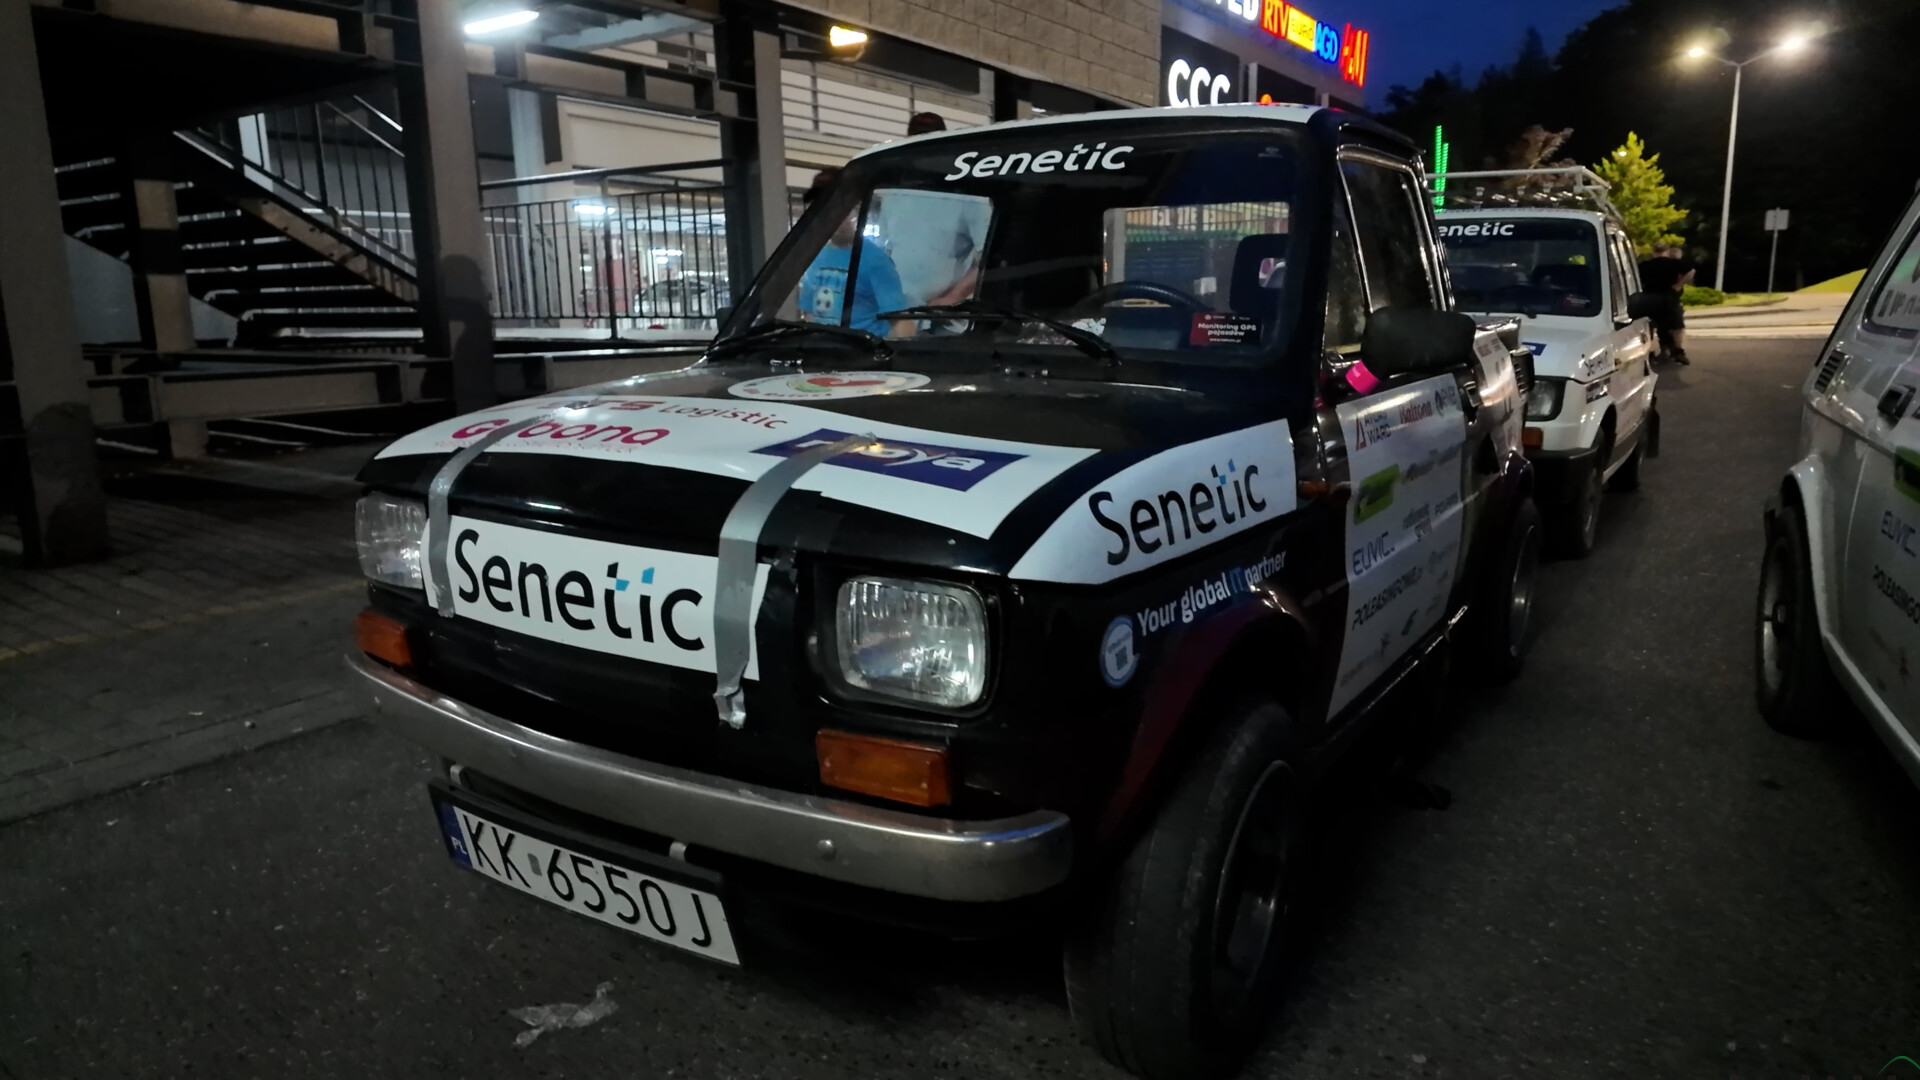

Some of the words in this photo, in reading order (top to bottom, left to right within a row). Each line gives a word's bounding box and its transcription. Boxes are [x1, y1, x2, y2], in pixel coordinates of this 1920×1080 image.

[1264, 0, 1289, 38] RTV
[1316, 22, 1339, 63] AGD
[1168, 58, 1230, 108] CCC
[944, 142, 1134, 181] Senetic
[1198, 322, 1239, 331] Monitoring
[1240, 323, 1257, 332] GPS
[658, 403, 788, 430] Logistic
[1089, 458, 1266, 565] Senetic
[455, 529, 705, 651] Senetic
[1137, 599, 1177, 637] Your
[1180, 573, 1231, 624] global
[1245, 550, 1288, 589] partner
[451, 836, 467, 856] PL
[462, 814, 531, 888] KK
[547, 848, 712, 948] 6550J
